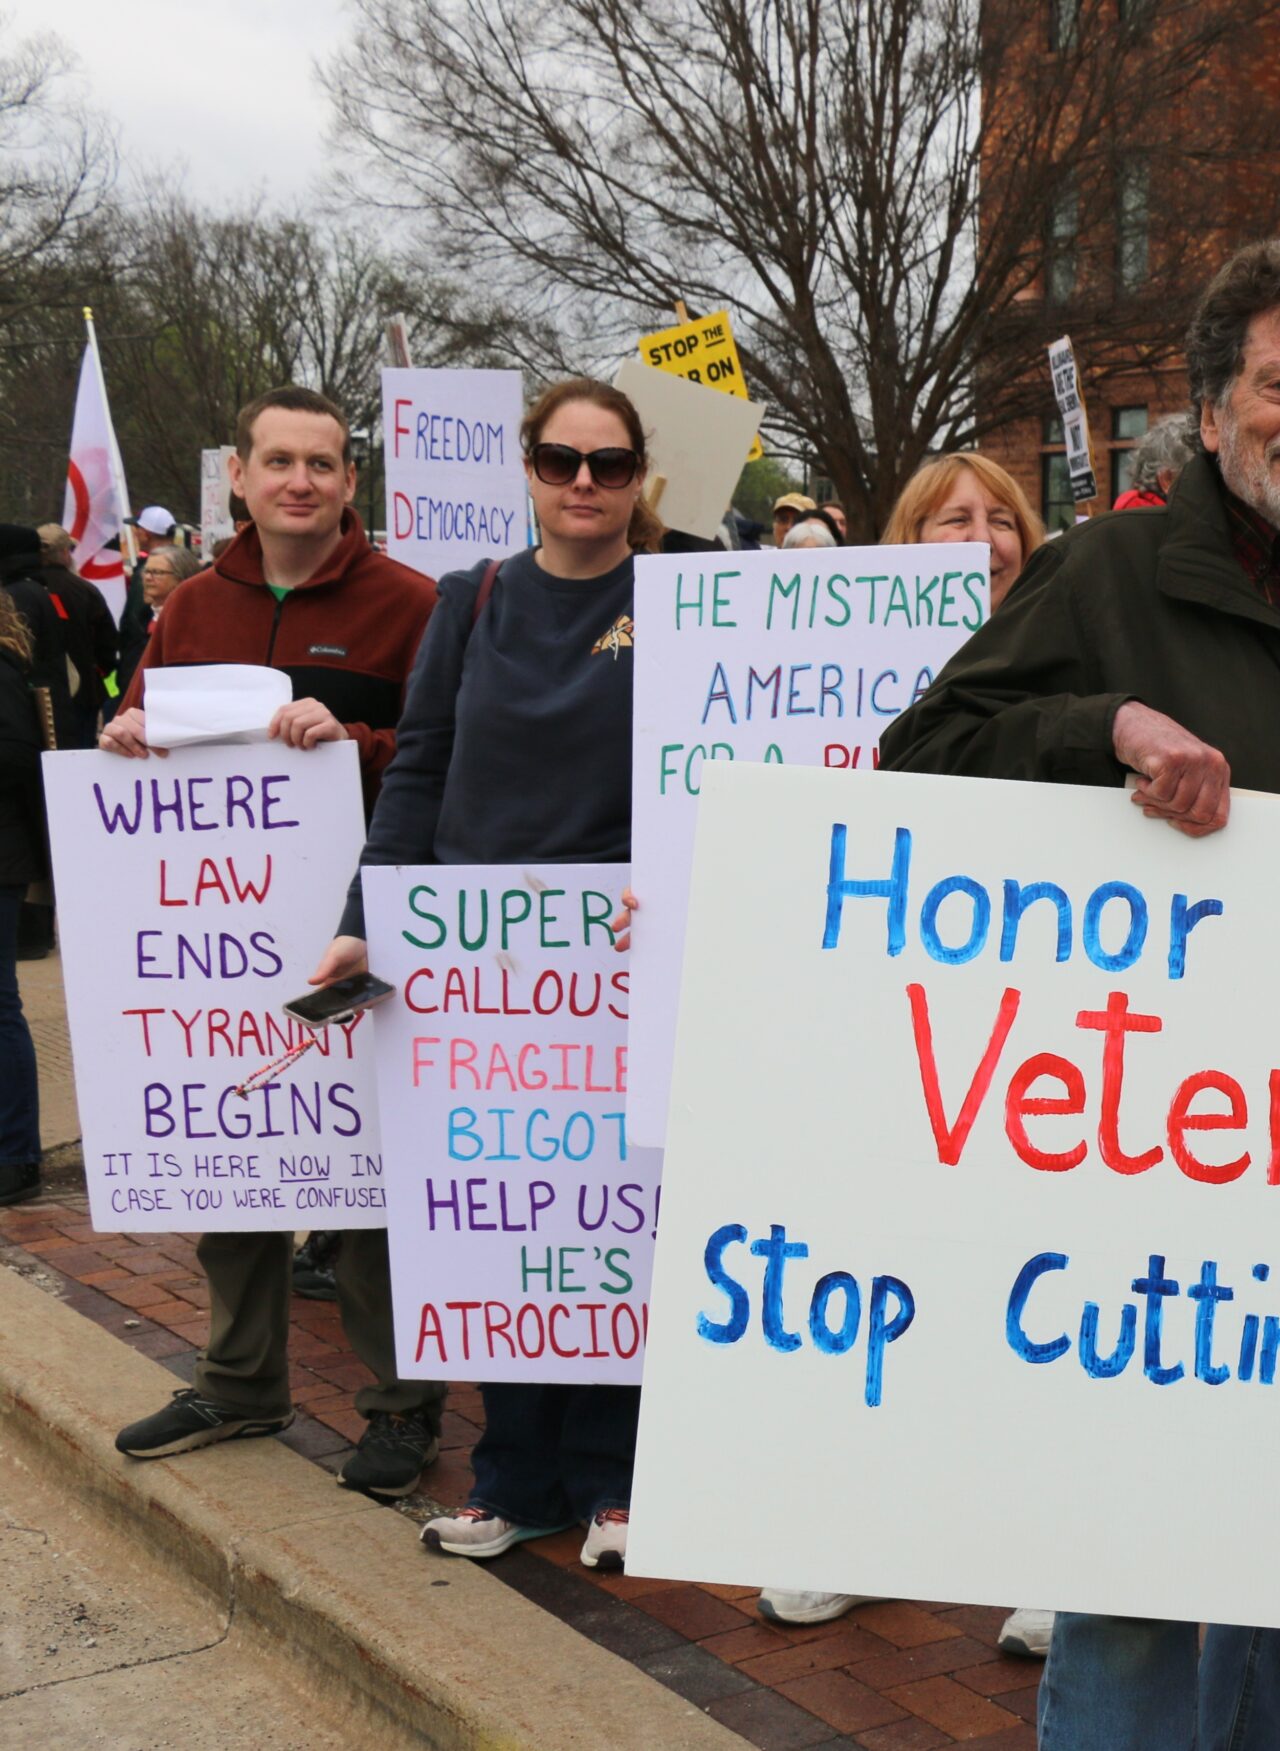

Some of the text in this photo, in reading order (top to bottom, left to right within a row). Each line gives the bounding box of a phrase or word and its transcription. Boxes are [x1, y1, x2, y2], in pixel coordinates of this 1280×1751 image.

[649, 324, 724, 366] STOP THE
[706, 356, 735, 382] ON
[394, 398, 505, 466] FREEDOM
[393, 491, 515, 547] DEMOCRACY
[676, 570, 985, 631] HE MISTAKES
[700, 660, 938, 726] AMERICA
[93, 775, 299, 835] WHERE
[160, 854, 272, 906] LAW
[822, 824, 1223, 979] Honor
[402, 885, 615, 951] SUPER
[137, 931, 283, 979] ENDS
[403, 967, 630, 1019] CALLOUS
[122, 1008, 364, 1059] TYRANNY
[411, 1037, 627, 1093] FRAGILE
[143, 1081, 362, 1140] BEGINS
[446, 1106, 629, 1164] BIGOT
[103, 1153, 383, 1178] IT IS HERE NOW IN
[111, 1188, 172, 1213] CASE
[181, 1189, 223, 1210] YOU
[233, 1188, 286, 1209] WERE
[426, 1178, 555, 1231] HELP
[521, 1246, 633, 1294] HE'S
[414, 1301, 648, 1361] ATROCIO
[697, 1224, 915, 1407] Stop
